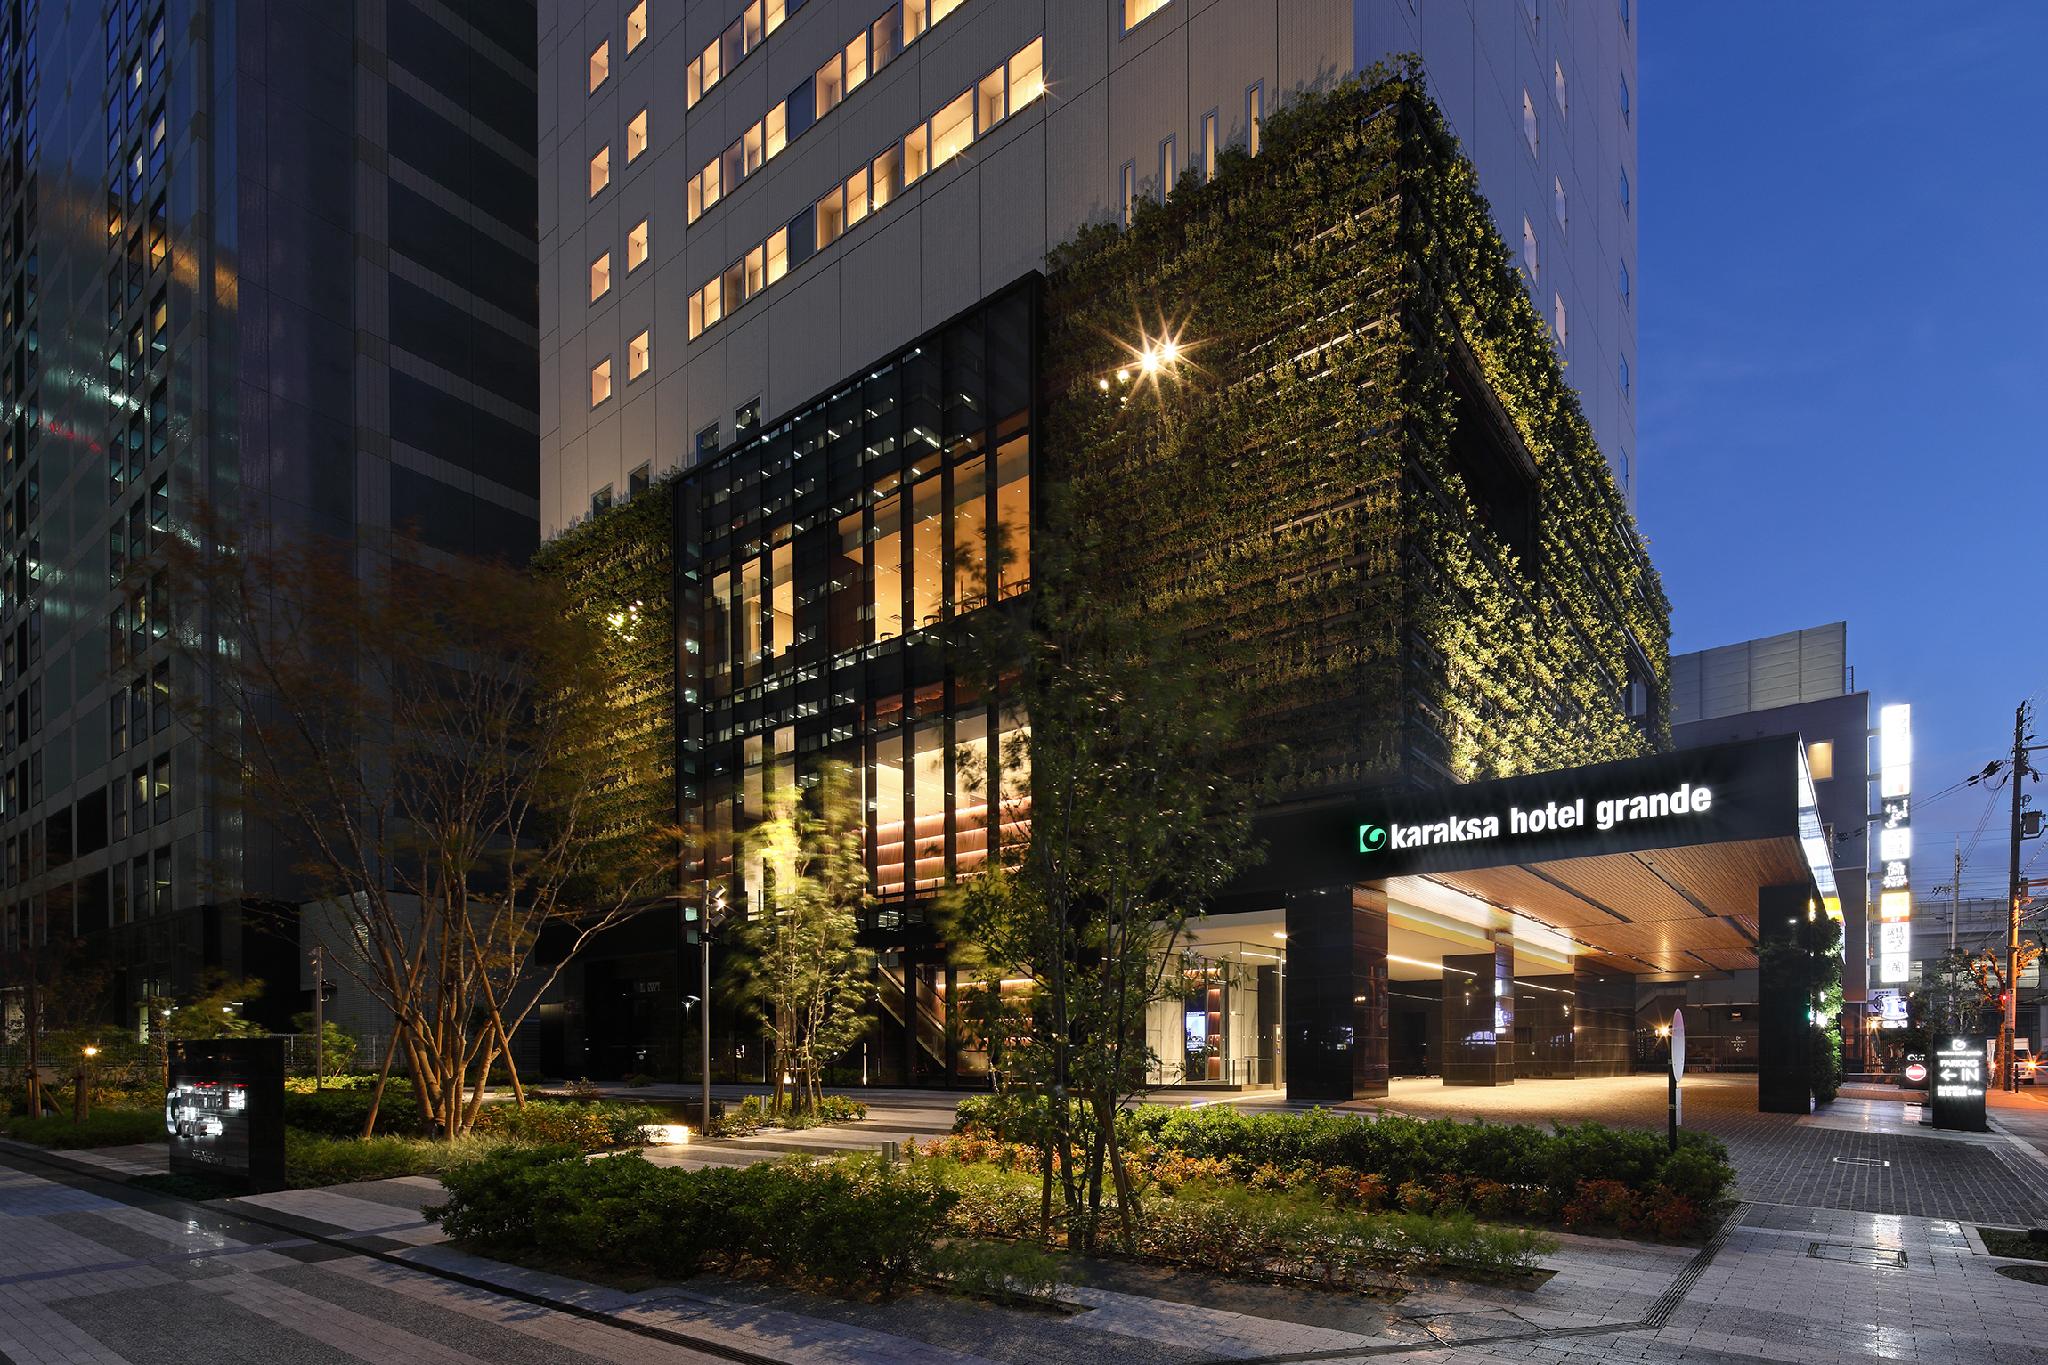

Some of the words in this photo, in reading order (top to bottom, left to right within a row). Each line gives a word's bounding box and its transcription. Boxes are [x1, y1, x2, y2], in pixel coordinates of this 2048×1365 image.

[1391, 815, 1499, 850] karaksa
[1510, 799, 1584, 834] hotel
[1596, 784, 1712, 830] grande
[1961, 1068, 1980, 1081] IN
